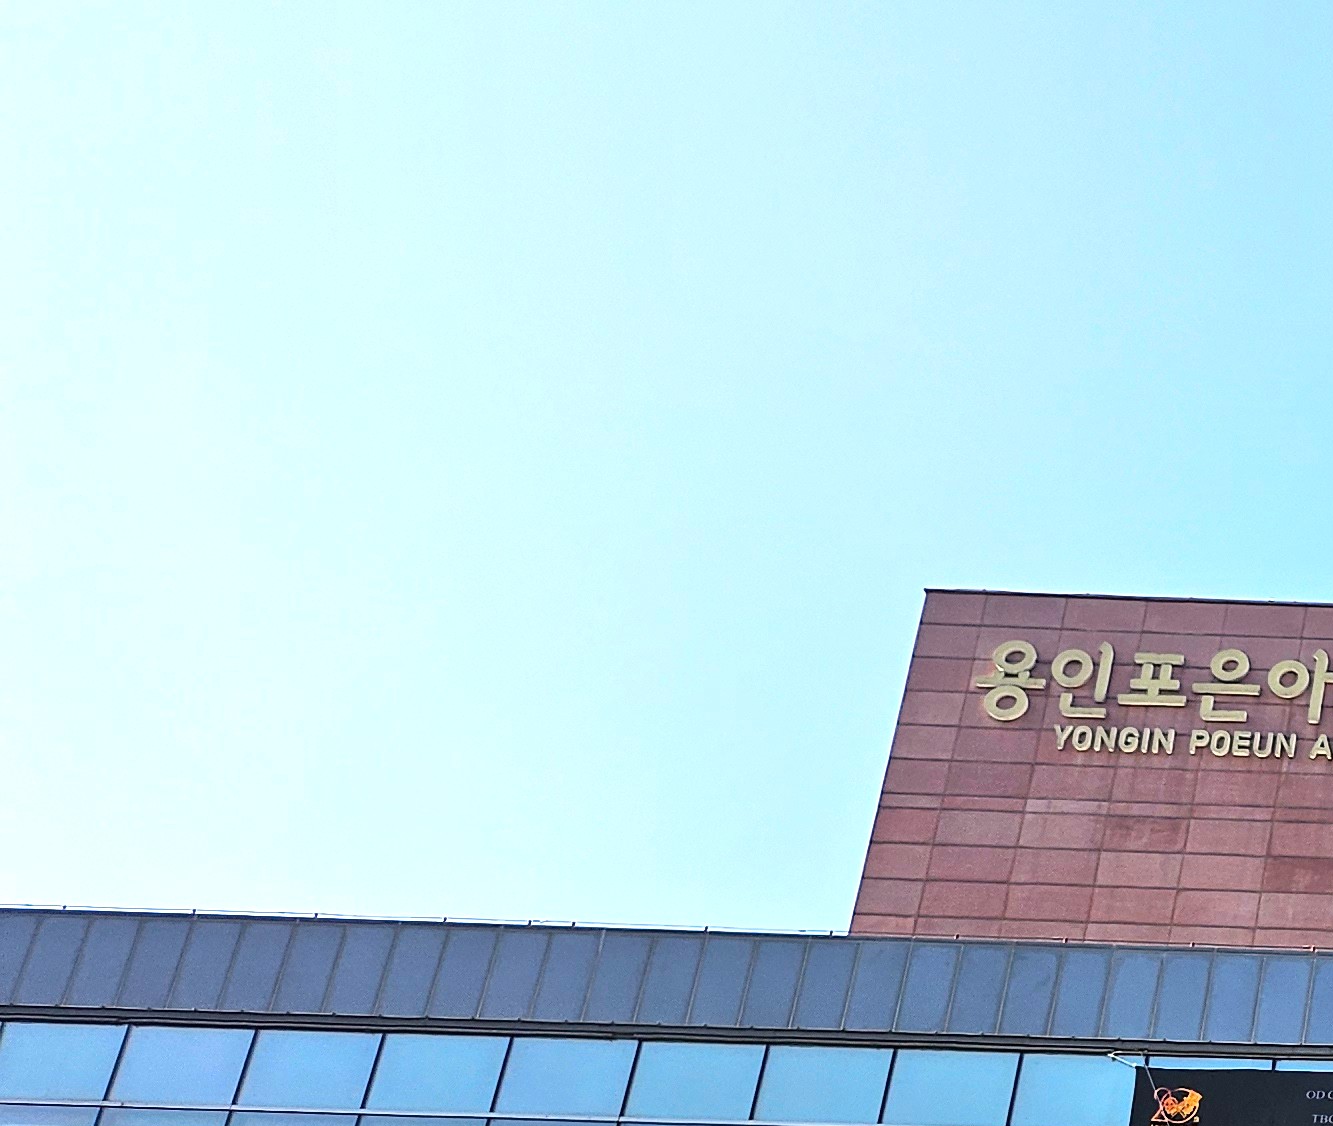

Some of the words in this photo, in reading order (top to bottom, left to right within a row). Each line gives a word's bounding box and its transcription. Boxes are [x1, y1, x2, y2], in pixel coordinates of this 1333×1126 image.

[1054, 724, 1175, 755] YONGIN
[1189, 730, 1297, 759] POEUN
[1306, 1090, 1325, 1099] OD
